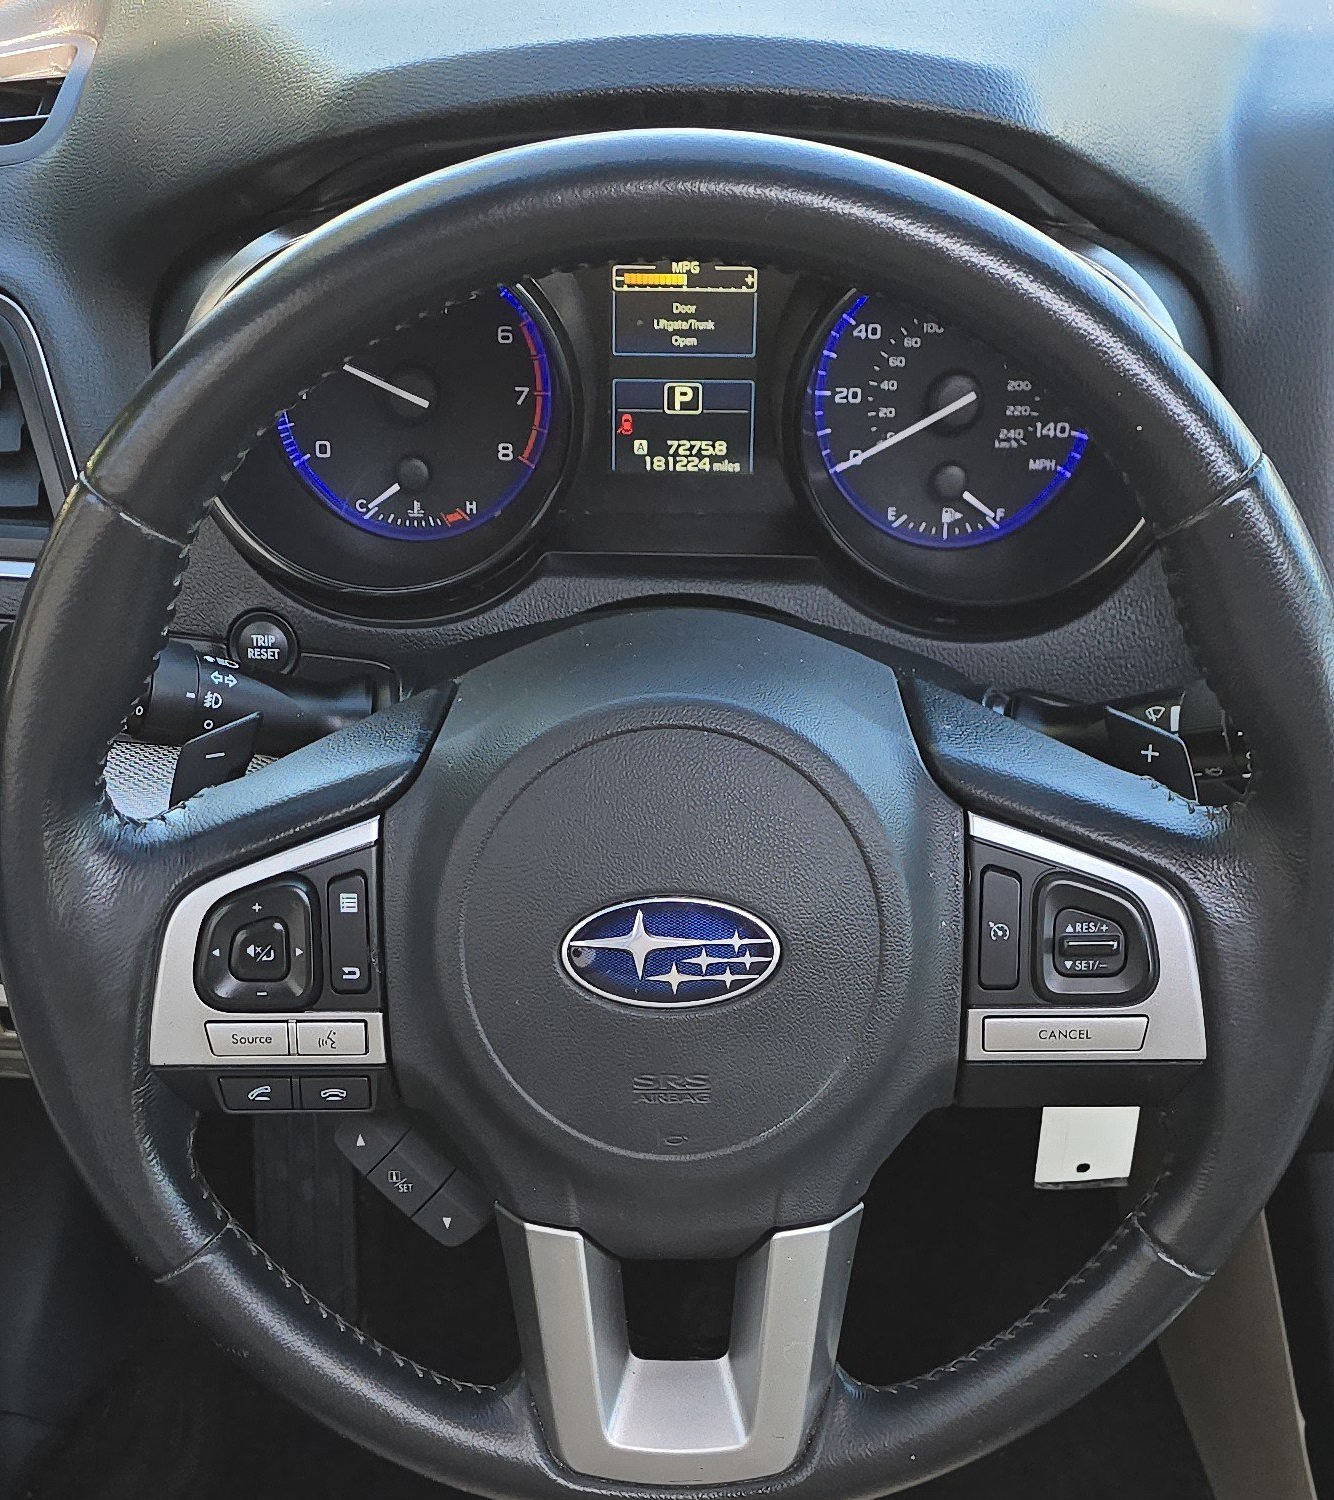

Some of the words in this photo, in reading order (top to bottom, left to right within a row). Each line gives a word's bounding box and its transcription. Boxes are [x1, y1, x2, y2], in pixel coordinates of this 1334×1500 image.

[671, 262, 699, 274] MPG
[673, 303, 696, 313] Door
[497, 326, 513, 344] 6
[853, 324, 882, 340] 40
[671, 336, 697, 347] Open
[888, 356, 906, 368] 60
[880, 380, 898, 391] 40
[1007, 380, 1032, 391] 200
[515, 386, 529, 405] 7
[675, 386, 693, 411] P
[834, 387, 862, 403] 20
[878, 407, 896, 418] 20
[1006, 406, 1031, 416] 220
[999, 429, 1024, 439] 240
[1036, 422, 1070, 438] 140
[315, 440, 331, 458] 0
[497, 443, 513, 461] 8
[667, 440, 727, 455] 7275.8
[645, 456, 710, 472] 181224
[713, 460, 741, 472] miles
[1029, 459, 1056, 470] MPH
[356, 499, 367, 512] C
[466, 501, 476, 514] H
[887, 507, 897, 521] E
[995, 508, 1006, 521] F
[251, 634, 276, 648] TRIP
[247, 648, 280, 661] RESET
[231, 1033, 273, 1045] Source
[1038, 1029, 1092, 1040] CANCEL
[633, 1073, 709, 1090] SRS
